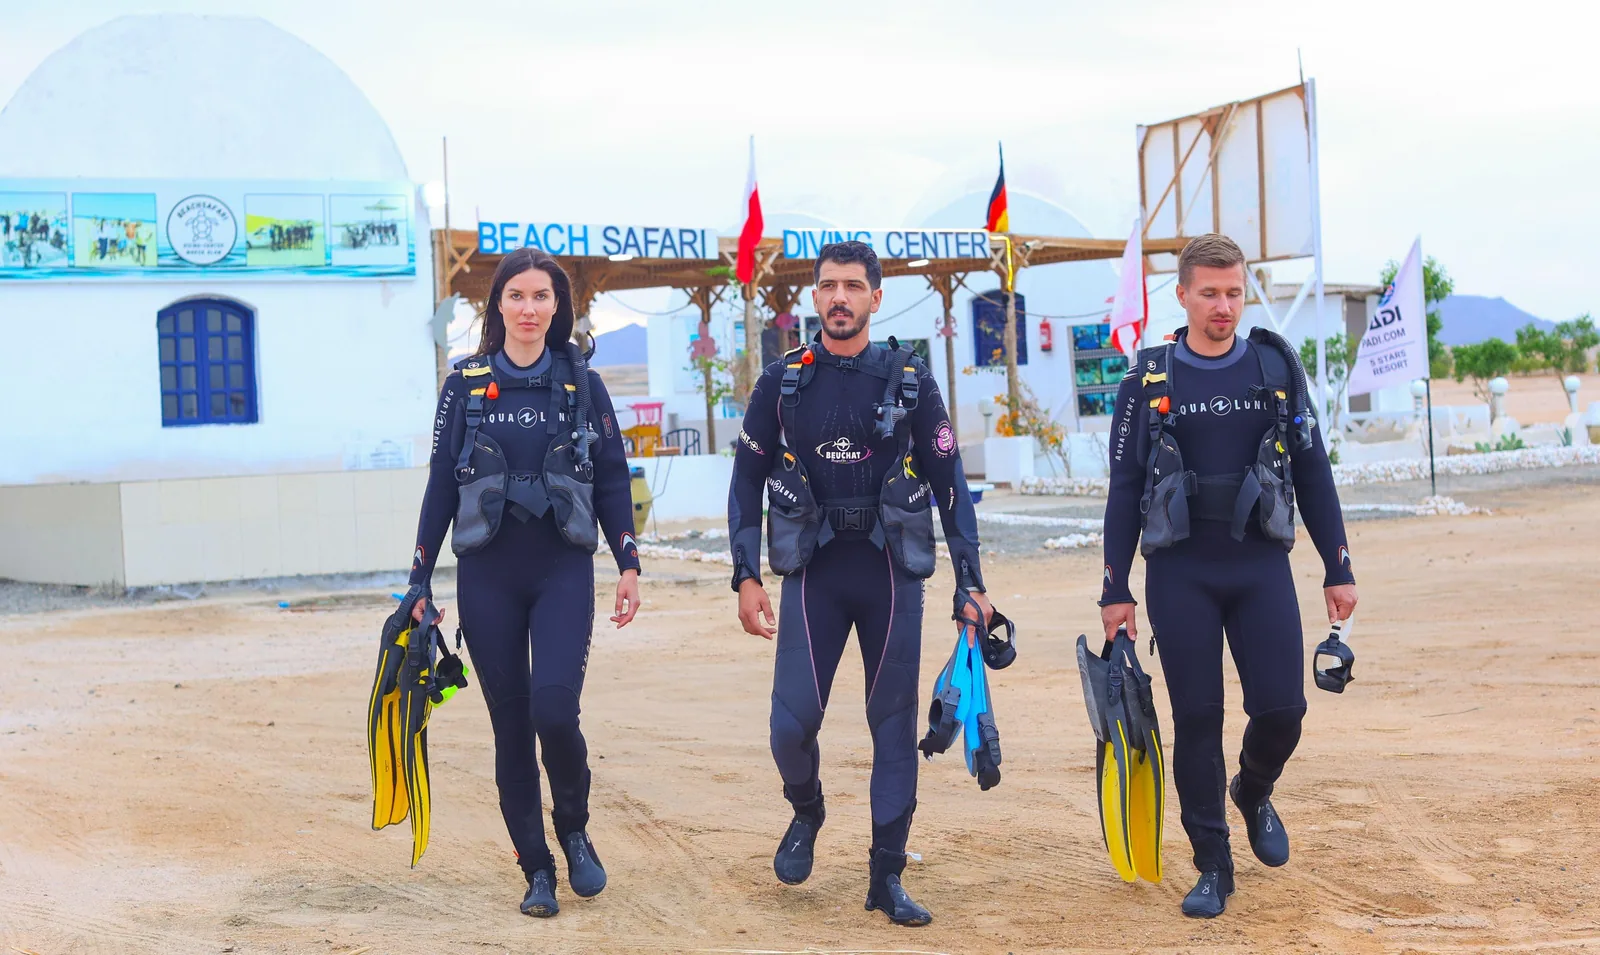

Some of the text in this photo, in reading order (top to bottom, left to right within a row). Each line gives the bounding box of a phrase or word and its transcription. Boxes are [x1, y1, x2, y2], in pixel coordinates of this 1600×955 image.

[478, 221, 706, 259] BEACH SAFARI
[885, 231, 988, 259] CENTER
[1369, 305, 1402, 331] ADI
[1373, 359, 1408, 376] RESORT
[1377, 349, 1406, 365] STARS
[440, 389, 454, 415] LUNG
[1180, 402, 1207, 415] QUA
[1115, 396, 1136, 461] AQUA LUNG
[825, 451, 861, 459] BEUCHAT
[779, 486, 798, 503] LUNG
